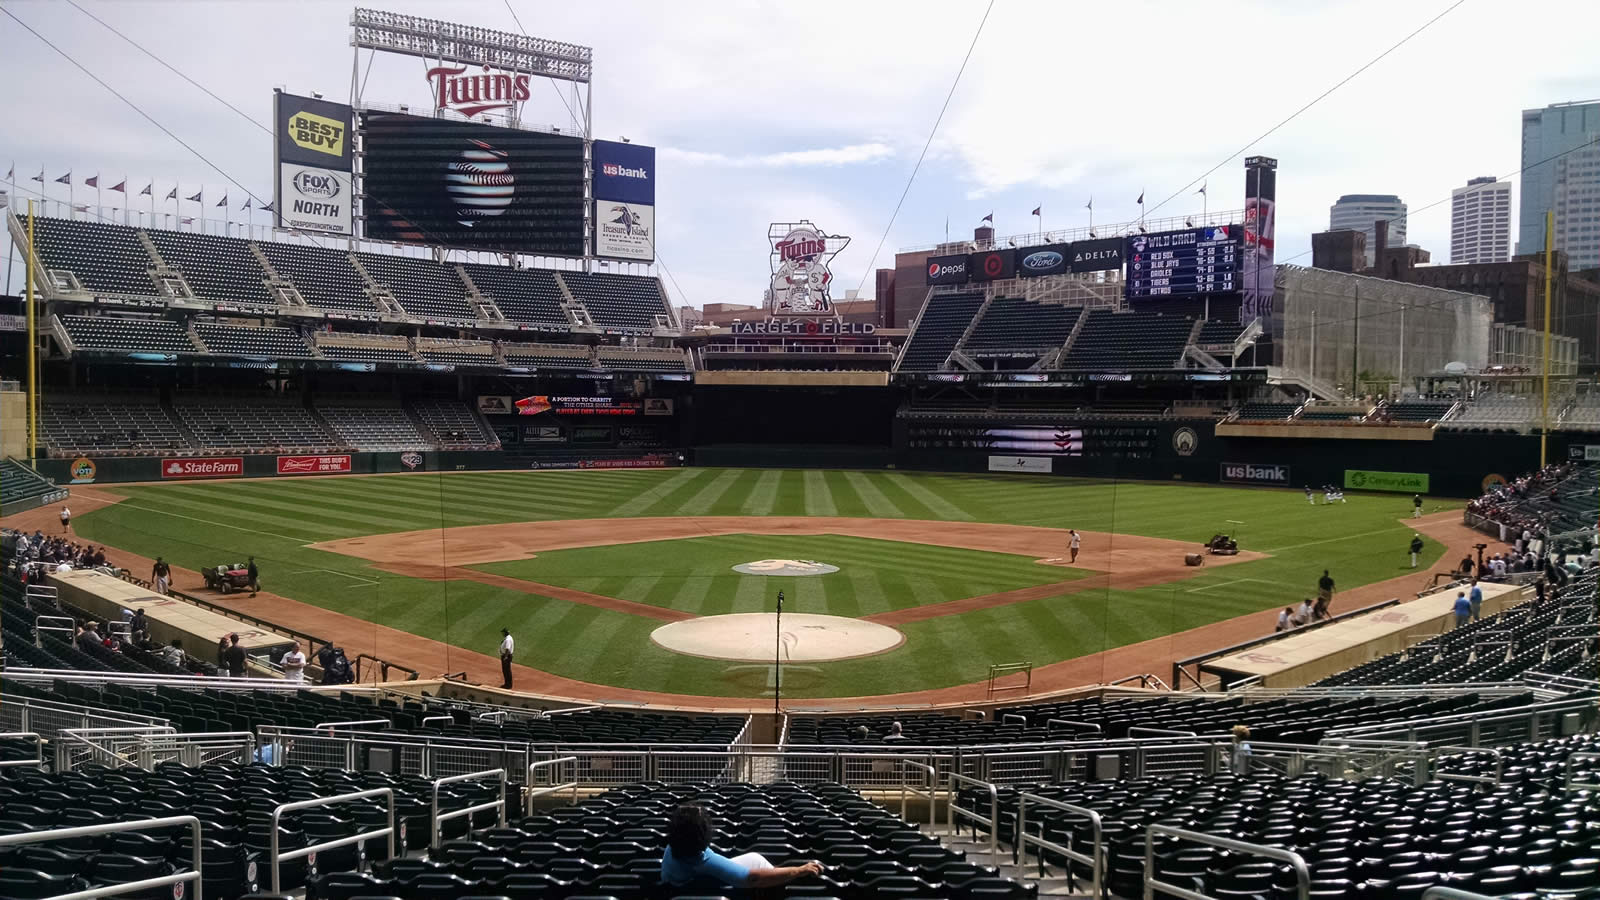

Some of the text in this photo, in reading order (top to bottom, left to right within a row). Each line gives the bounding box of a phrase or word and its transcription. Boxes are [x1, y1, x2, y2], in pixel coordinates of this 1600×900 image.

[427, 64, 531, 114] Twins
[296, 116, 342, 139] BEST
[296, 129, 338, 149] BUY
[302, 174, 330, 190] FOX
[302, 186, 331, 196] SPORTS
[294, 200, 340, 218] NORTH
[290, 220, 344, 232] FOXSPORTSNORTH.COM
[602, 224, 648, 237] Treasure Island
[1148, 236, 1170, 248] WILD
[1172, 233, 1196, 246] CARD
[775, 237, 826, 262] Twins
[1086, 249, 1118, 260] DELTA
[1162, 251, 1174, 259] SOX
[1030, 255, 1054, 268] Ford
[1151, 260, 1165, 268] BLUE
[942, 262, 965, 276] pepsi
[1150, 269, 1172, 278] ORIOLES
[1150, 286, 1172, 295] ASTROS
[732, 323, 876, 334] TARGET FIELD
[1368, 476, 1421, 487] CenturyLink
